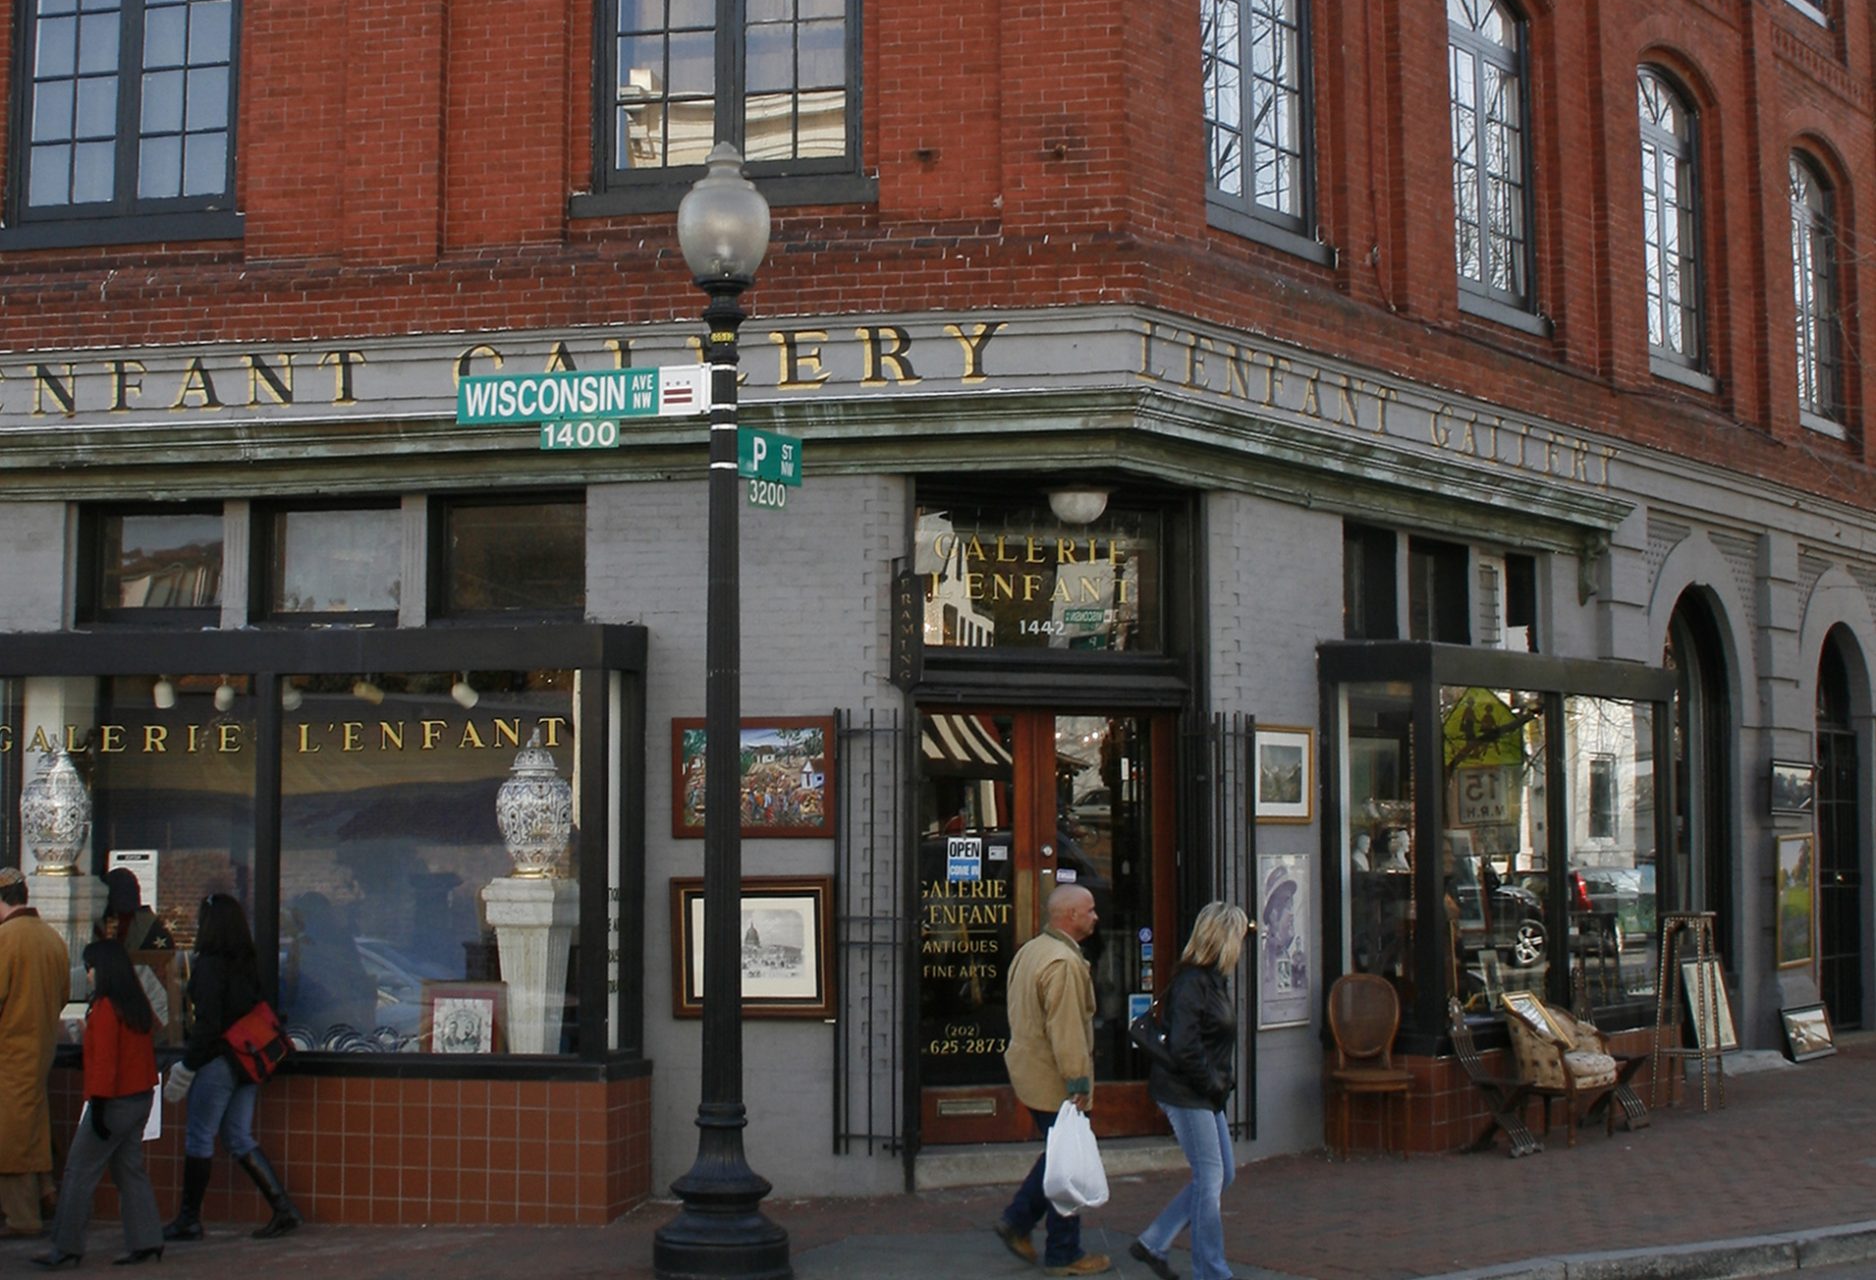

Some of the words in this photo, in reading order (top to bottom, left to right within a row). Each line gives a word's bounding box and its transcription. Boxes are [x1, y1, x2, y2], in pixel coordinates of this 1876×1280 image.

[0, 351, 366, 417] NFANT
[453, 322, 1009, 391] GAERY
[632, 374, 653, 390] AVE
[465, 375, 626, 417] WISCONSIN
[633, 392, 651, 409] NW
[543, 422, 616, 447] 1400
[753, 436, 767, 471] P
[781, 444, 794, 460] ST
[1430, 403, 1622, 492] GALLERY
[781, 461, 794, 477] NW
[750, 479, 786, 507] 3200
[933, 532, 1127, 567] GALERIE
[1019, 620, 1066, 636] 1442
[298, 717, 567, 753] L'ENFANT
[950, 841, 980, 858] OPEN
[950, 865, 970, 876] COME
[922, 941, 998, 953] ANTIQUES
[923, 965, 955, 978] FINE
[959, 965, 997, 978] ARTS
